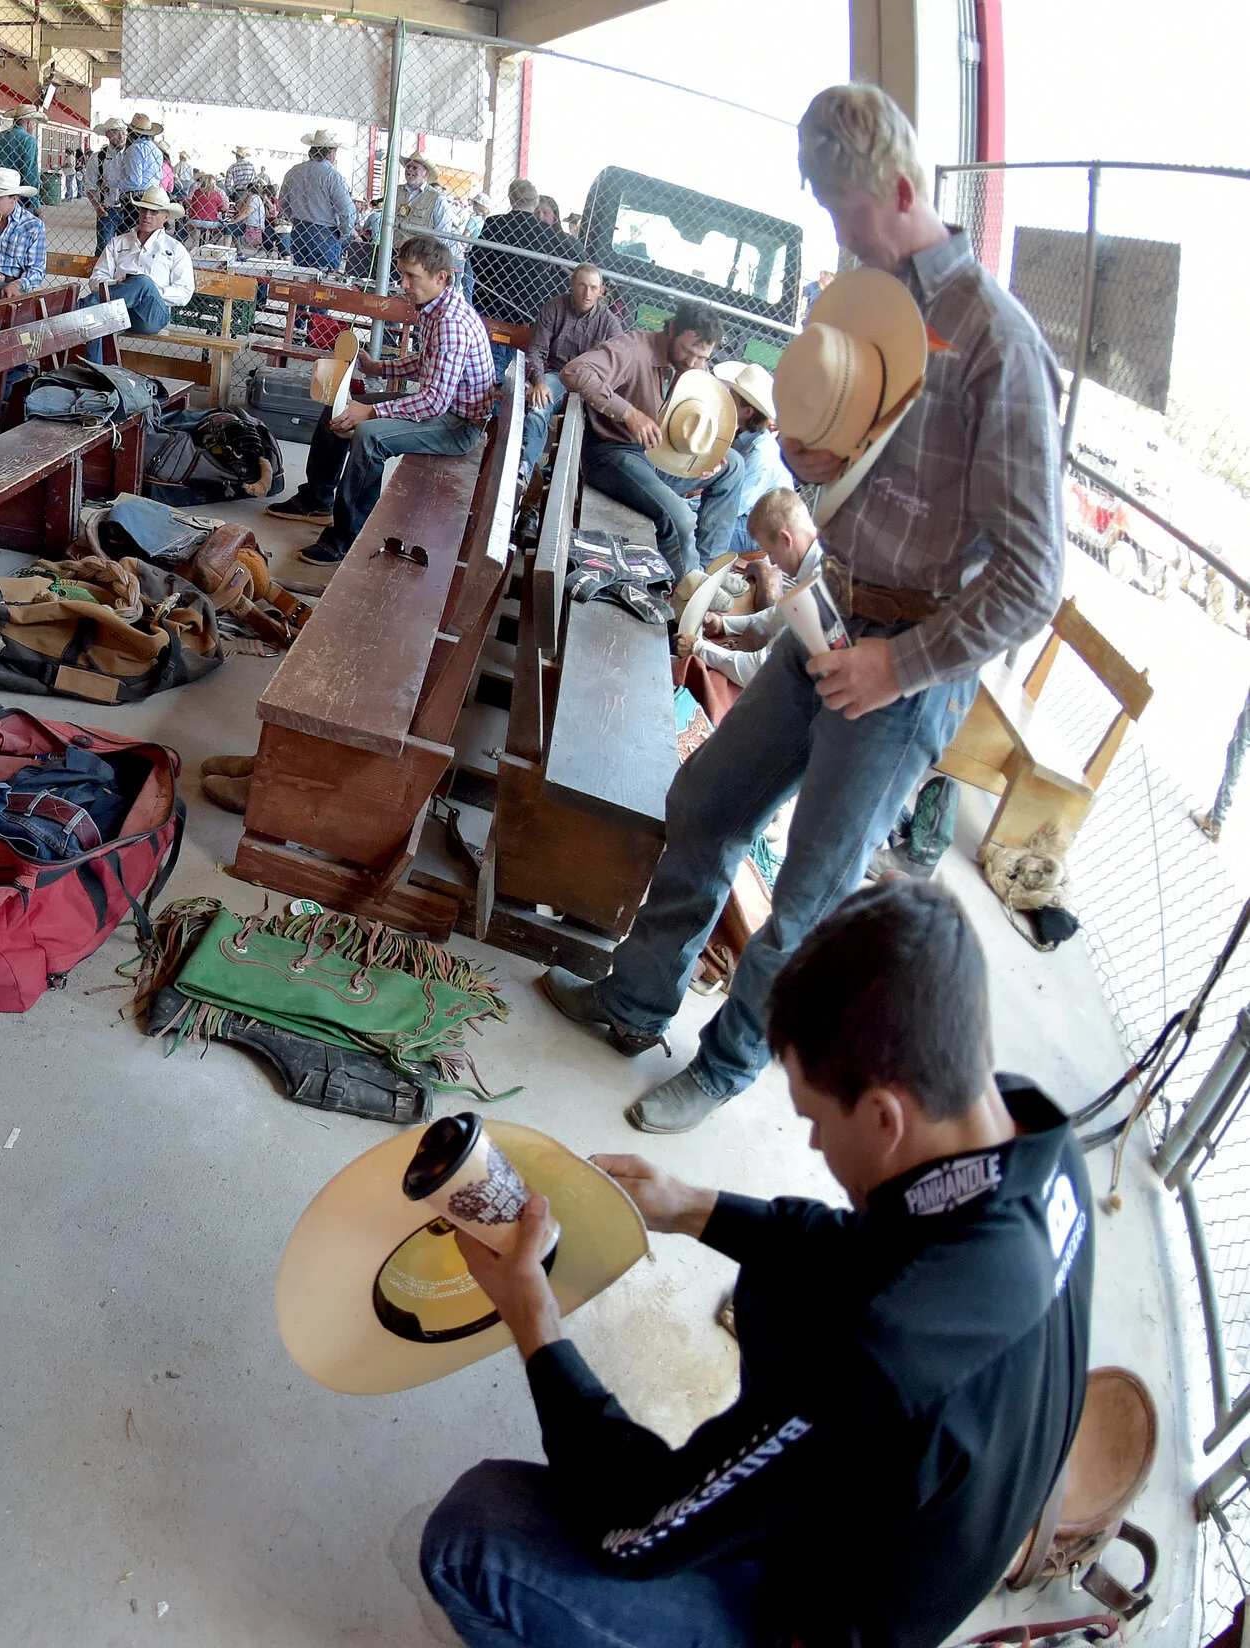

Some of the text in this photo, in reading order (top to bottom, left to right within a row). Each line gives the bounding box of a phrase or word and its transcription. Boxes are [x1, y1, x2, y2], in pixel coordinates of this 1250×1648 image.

[479, 1170, 507, 1204] LOVE
[904, 1153, 1002, 1215] PANHANDLE
[678, 1415, 813, 1516] BAILEY
